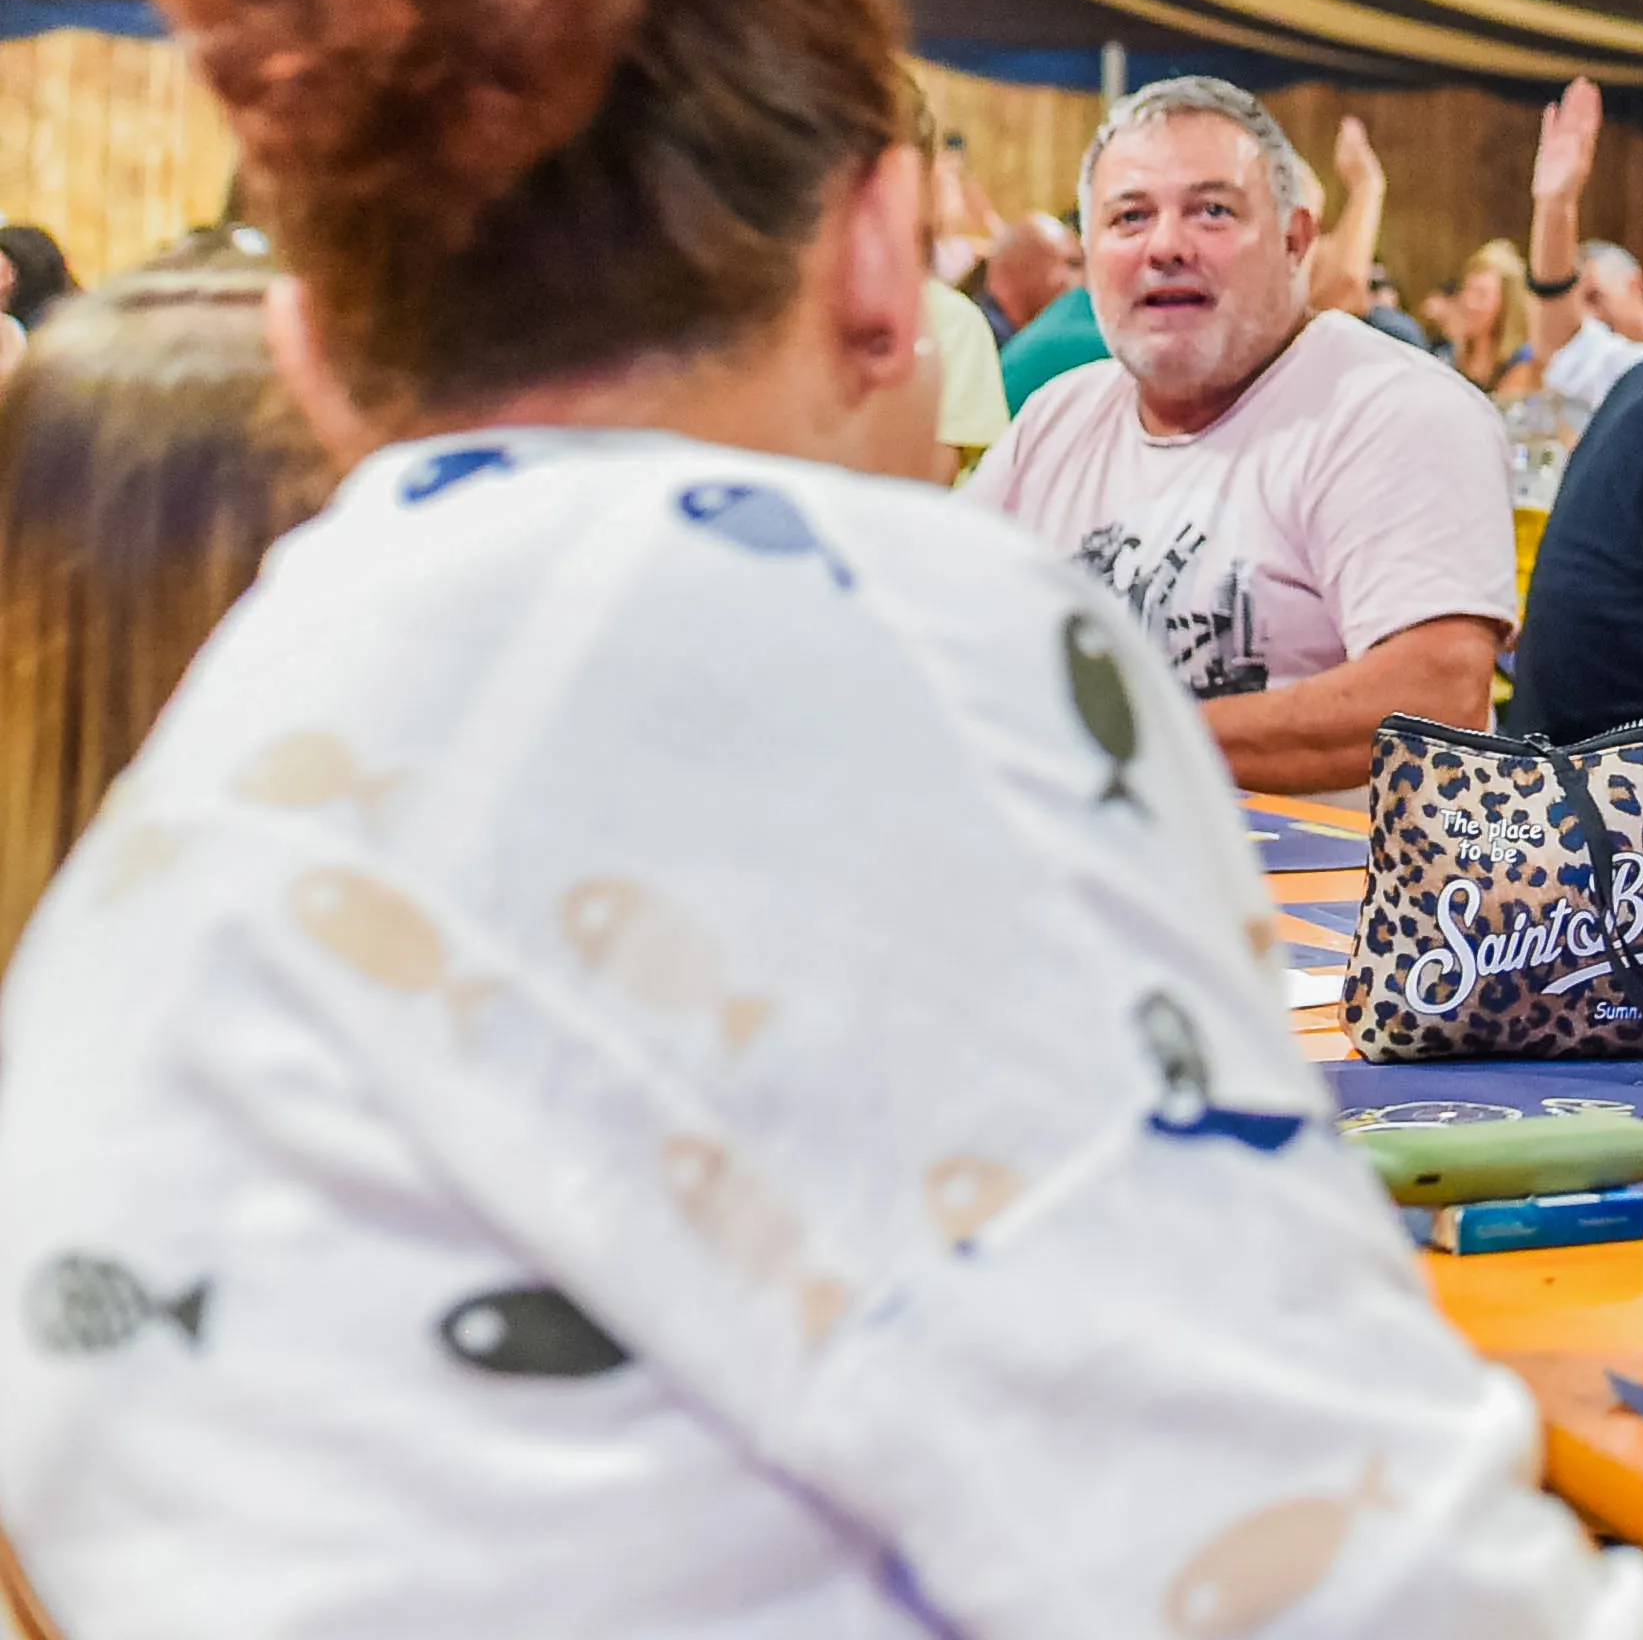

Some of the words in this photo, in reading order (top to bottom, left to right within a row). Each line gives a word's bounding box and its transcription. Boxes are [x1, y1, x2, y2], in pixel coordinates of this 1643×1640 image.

[1440, 808, 1480, 836] The
[1487, 819, 1543, 842] place
[1458, 838, 1482, 862] to
[1490, 840, 1518, 864] be
[1404, 878, 1574, 1016] Saint
